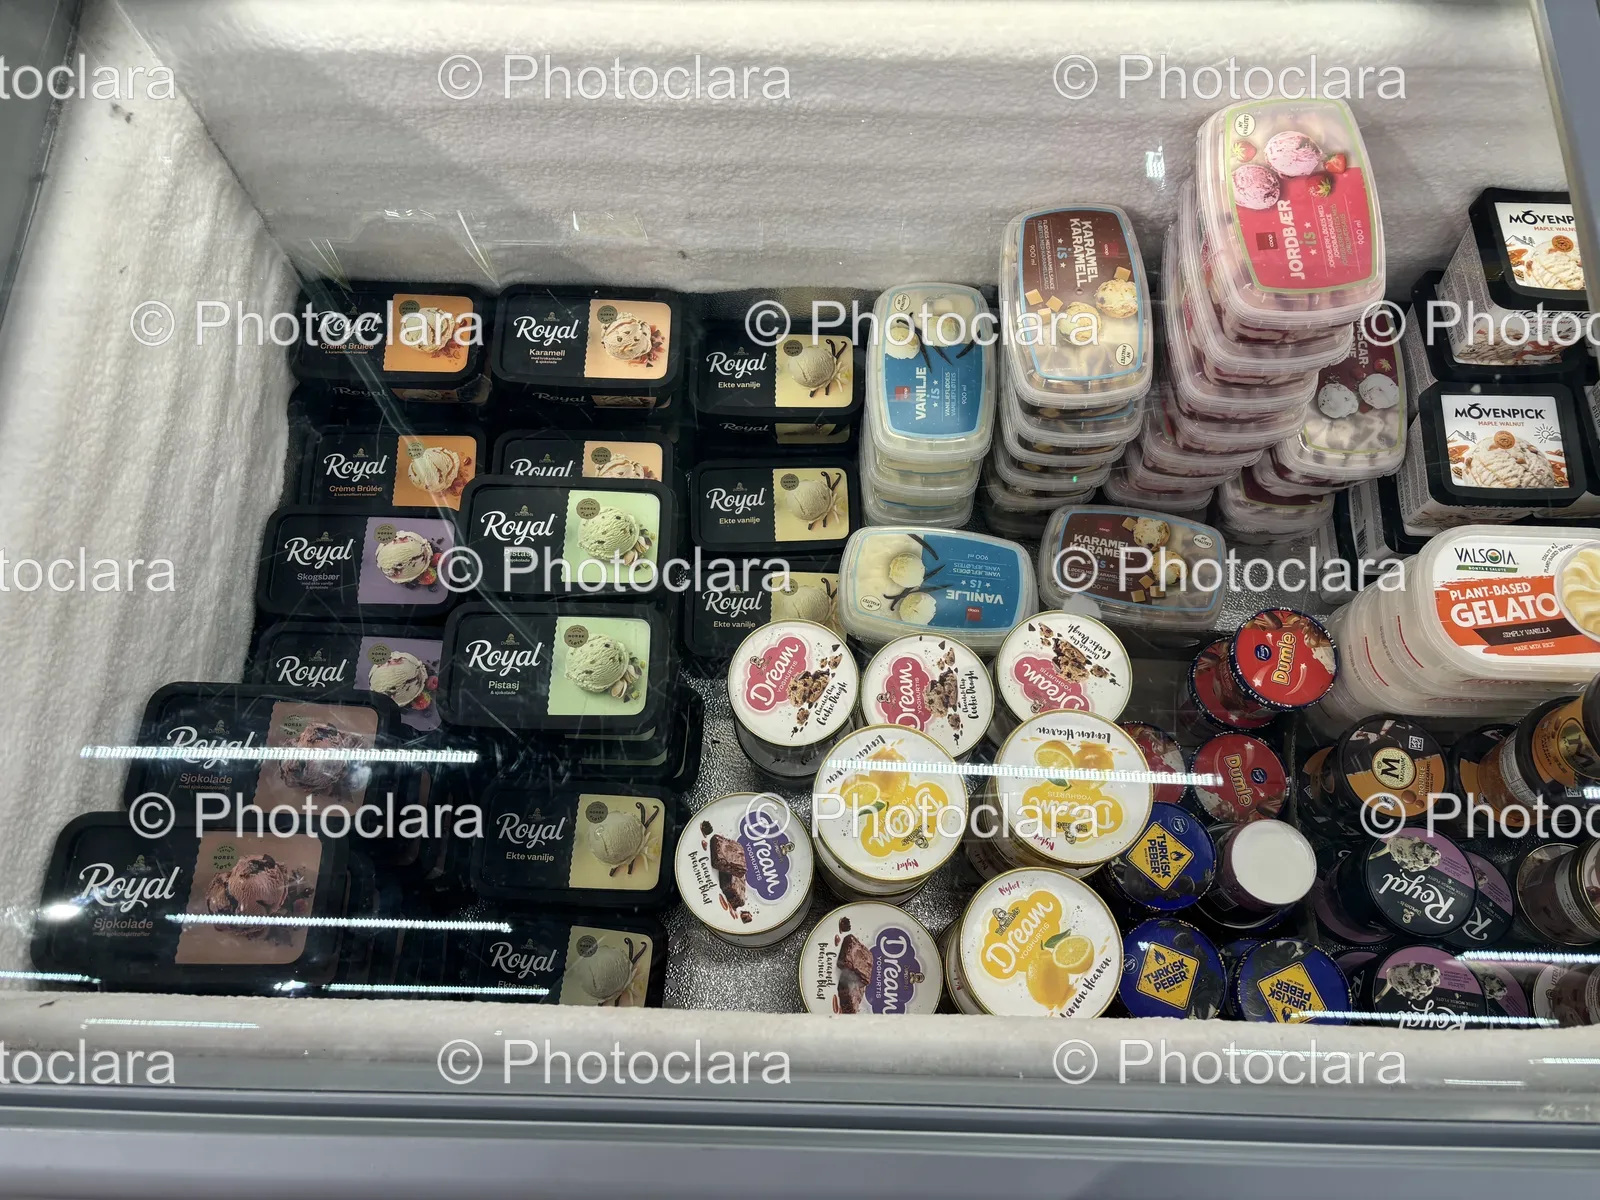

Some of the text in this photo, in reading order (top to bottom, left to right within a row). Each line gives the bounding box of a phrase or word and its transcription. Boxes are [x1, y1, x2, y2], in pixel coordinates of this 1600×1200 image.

[1080, 220, 1099, 283] KARAMEL
[1277, 199, 1305, 280] JORDBÆR
[1356, 229, 1364, 244] 900
[1070, 218, 1088, 288] KARAMELL
[513, 315, 580, 347] Royal
[529, 348, 566, 358] Karamell
[705, 351, 769, 379] Royal
[531, 392, 588, 403] Royal
[736, 381, 761, 390] vanilje
[915, 366, 927, 421] VANILJE
[719, 422, 770, 432] Royal
[323, 453, 388, 482] Royal
[510, 457, 575, 478] Royal
[329, 484, 383, 493] Crème Brûlée
[706, 487, 766, 515] Royal
[480, 510, 557, 546] Royal
[719, 516, 761, 525] Ekte vanilje
[284, 537, 353, 570] Royal
[975, 553, 989, 561] 900
[1069, 542, 1135, 560] KARAMELL
[1074, 533, 1129, 549] KARAMEL
[1454, 547, 1517, 566] VALSOIA
[296, 572, 340, 582] Skogsbær
[1450, 582, 1532, 602] PLANT-BASED
[702, 590, 763, 618] Royal
[945, 589, 1004, 605] VANILJE
[1450, 592, 1561, 628] GELATO
[713, 620, 756, 629] Ekte vanilje
[1502, 627, 1552, 638] SIMPLY VANILLA
[465, 639, 543, 677] Royal
[1067, 624, 1112, 660] Cookie Dough
[275, 655, 346, 688] Royal
[750, 643, 800, 706] Dream
[1272, 632, 1296, 685] Dumle
[488, 680, 520, 691] Pistasj
[778, 660, 798, 693] YOGHURTIS
[1040, 667, 1072, 693] YOGHURTIS
[816, 682, 848, 726] Cookie Dough
[915, 677, 923, 714] YOGHURTIS
[965, 670, 979, 719] Cookie Dough
[166, 725, 257, 770] Royal
[852, 735, 887, 761] Lemon
[1036, 727, 1111, 744] Lemon Heaven
[180, 772, 233, 785] Sjokolade
[1224, 753, 1254, 806] Dumle
[1418, 766, 1426, 796] DOUBLE
[1048, 791, 1092, 801] YOGHURTIS
[495, 812, 567, 850] Royal
[506, 851, 555, 862] Ekte vanilje
[744, 817, 781, 896] Dream
[745, 843, 762, 881] YOGHURTIS
[1147, 839, 1160, 874] PEBER
[79, 862, 181, 914] Royal
[688, 851, 713, 905] Brownie Blast
[698, 856, 718, 890] Caramel
[998, 880, 1021, 896] Nyhet
[1378, 871, 1456, 925] Royal
[93, 917, 154, 932] Sjokolade
[986, 901, 1054, 974] Dream
[1019, 922, 1050, 960] YOGHURTIS
[489, 941, 559, 980] Royal
[816, 942, 829, 1000] Brownie Blast
[826, 951, 838, 988] Caramel
[880, 935, 907, 1014] Dream
[1082, 956, 1113, 991] Heaven
[875, 955, 883, 999] YOGHURTIS
[1153, 970, 1189, 993] PEBER
[1275, 978, 1312, 1001] PEBER
